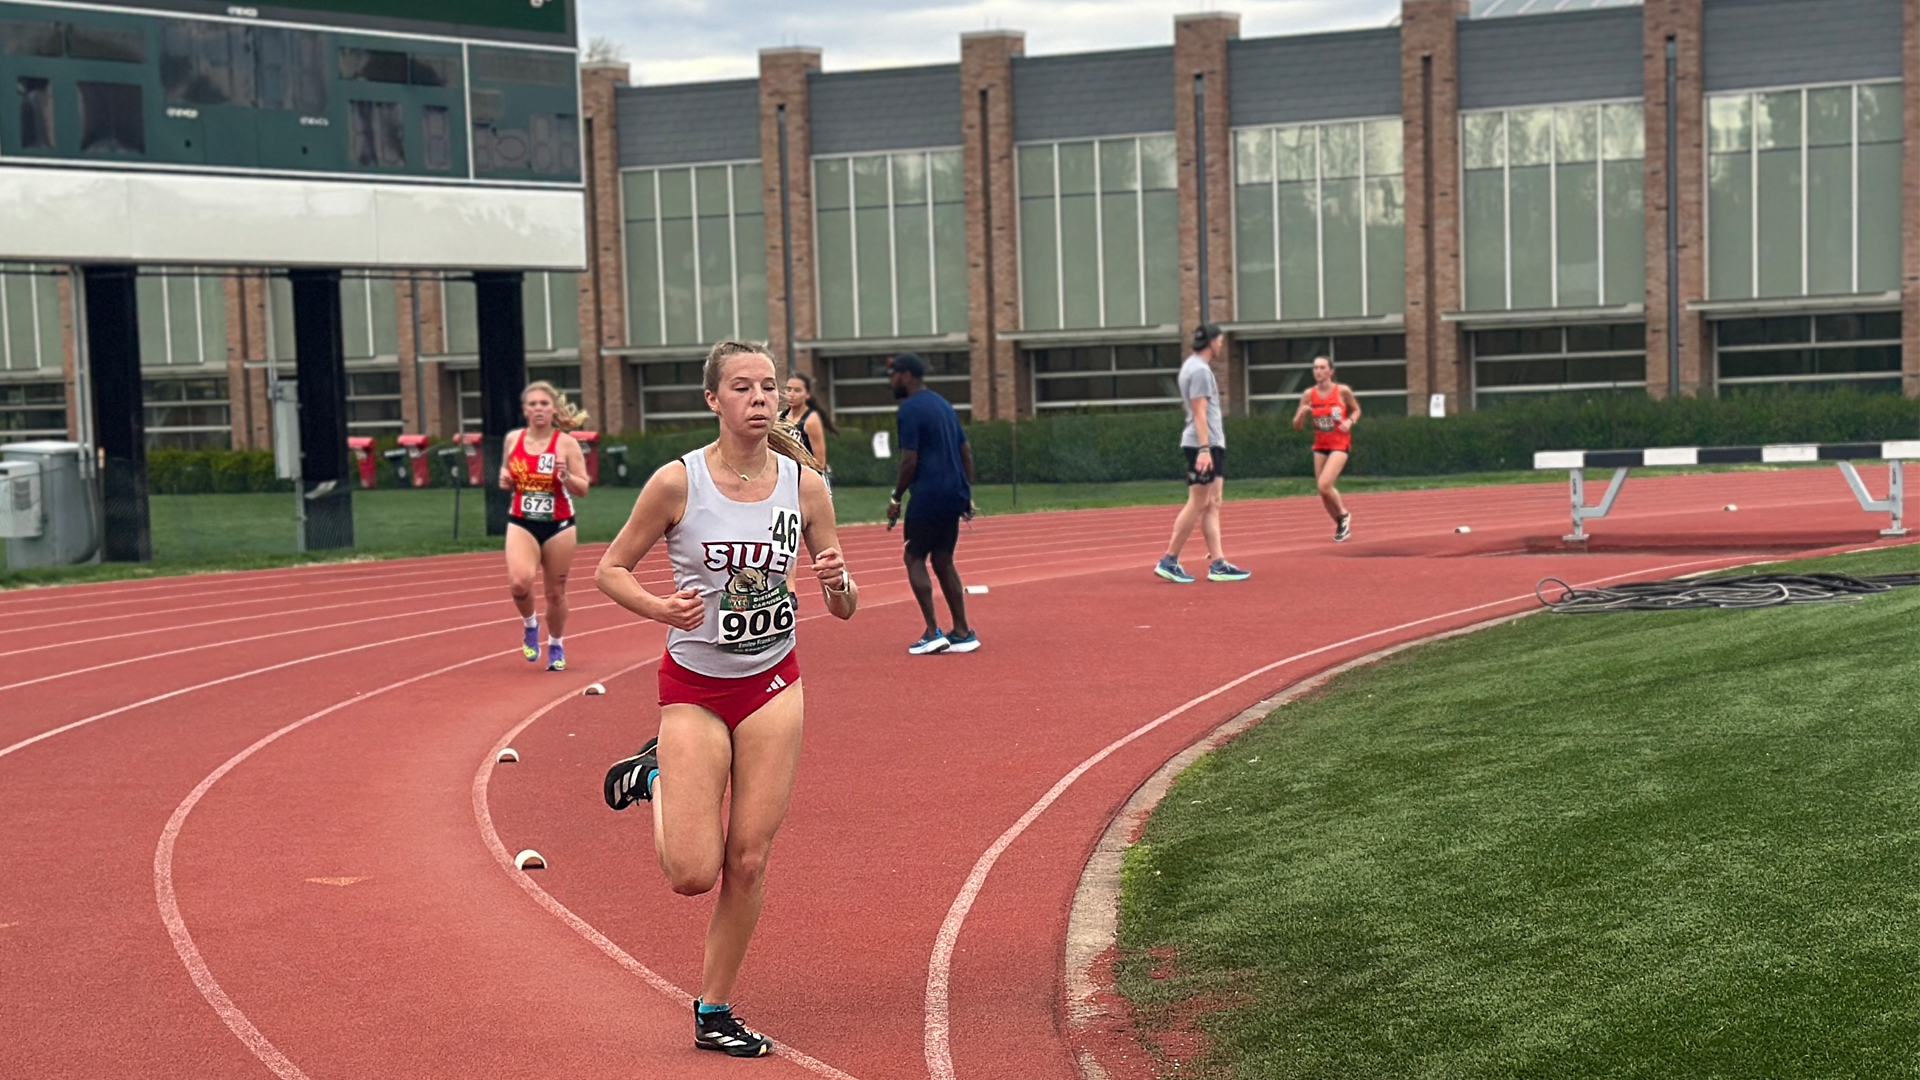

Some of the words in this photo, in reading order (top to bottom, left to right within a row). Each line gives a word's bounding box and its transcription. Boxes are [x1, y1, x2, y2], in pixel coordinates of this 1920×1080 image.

[538, 455, 554, 472] 34
[523, 497, 553, 512] 673
[772, 511, 798, 553] 46
[701, 542, 789, 574] SIUE
[752, 595, 782, 609] CARNIVAL
[753, 587, 780, 603] DISTANCE
[722, 601, 794, 641] 906
